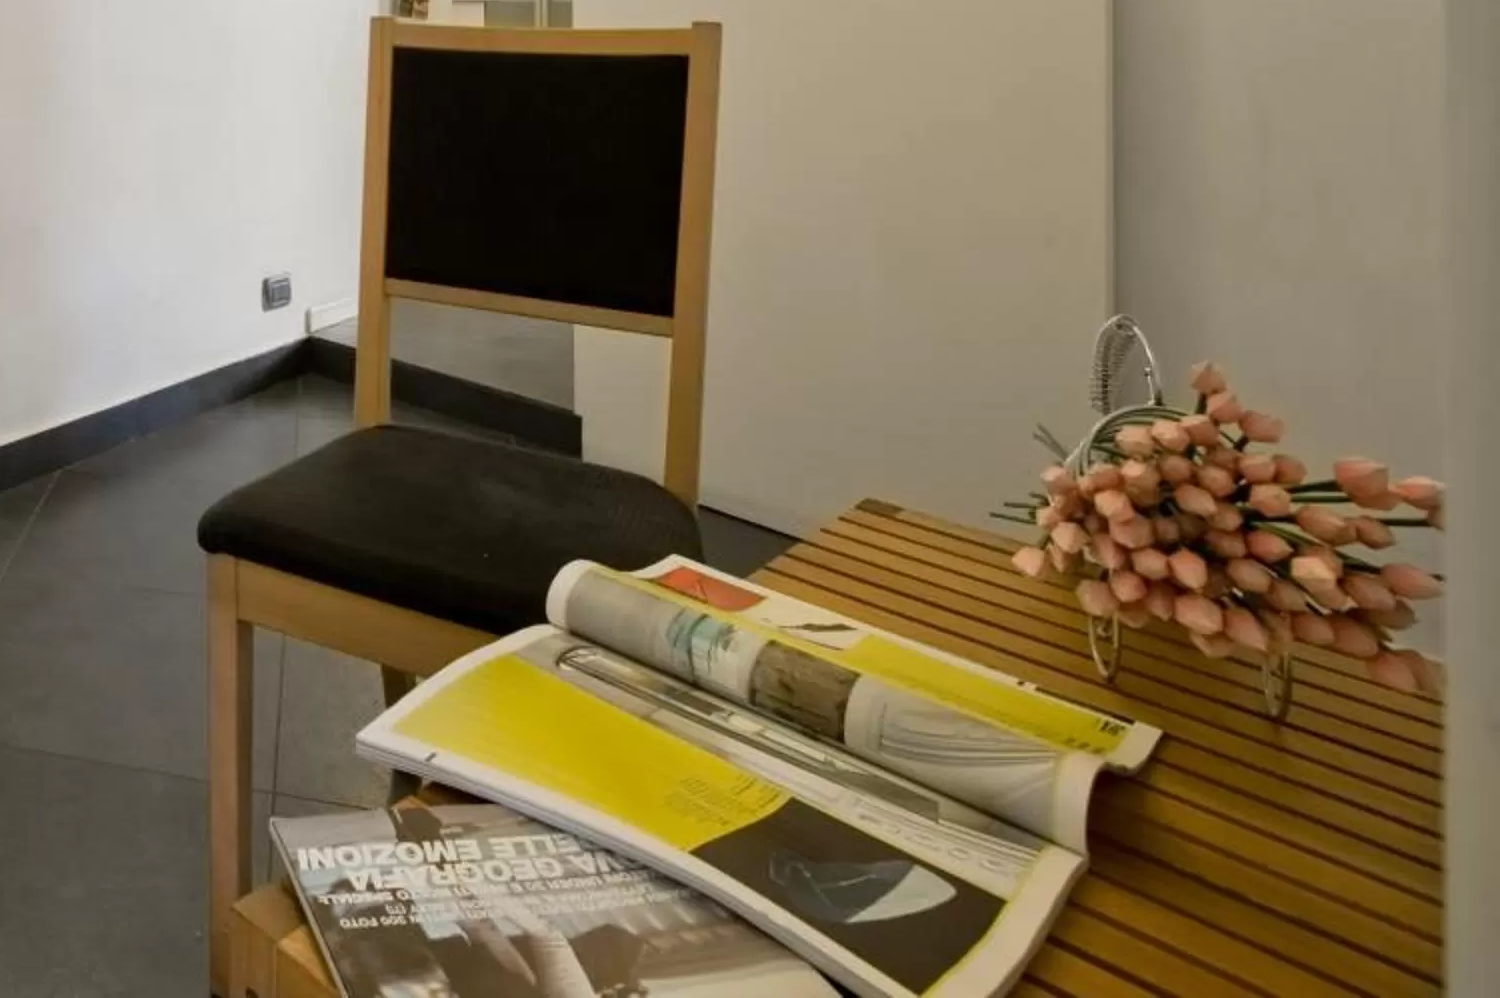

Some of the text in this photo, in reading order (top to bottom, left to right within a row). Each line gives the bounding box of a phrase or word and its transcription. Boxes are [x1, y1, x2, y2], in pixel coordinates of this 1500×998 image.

[298, 833, 582, 870] ELLE EMOZIONI
[348, 856, 565, 891] GEOGRAFIA
[339, 916, 379, 930] FOTO
